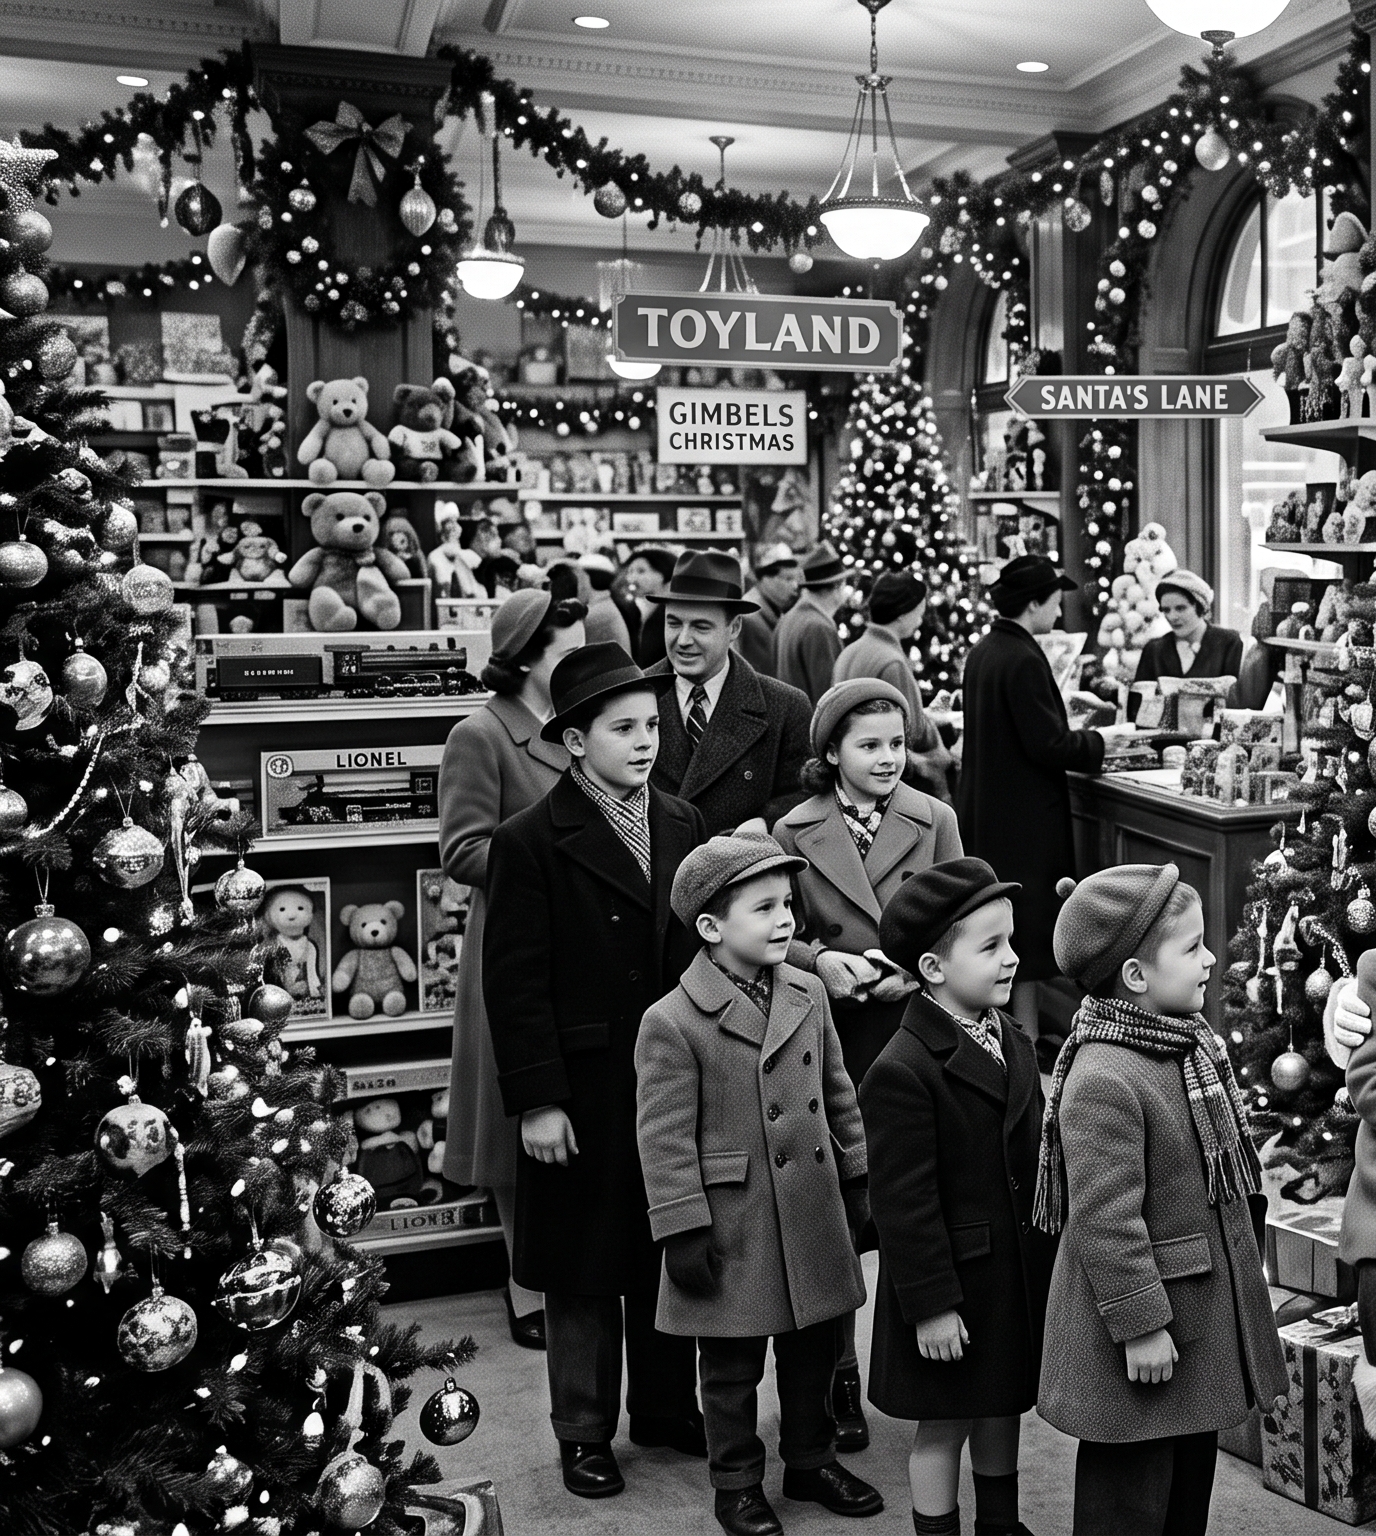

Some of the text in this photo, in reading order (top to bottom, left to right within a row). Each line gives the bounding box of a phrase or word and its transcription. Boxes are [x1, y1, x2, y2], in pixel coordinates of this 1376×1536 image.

[637, 307, 880, 354] TOYLAND
[1040, 385, 1229, 410] SANTA'S LANE
[669, 401, 794, 426] GIMBELS
[669, 432, 794, 451] CHRISTMAS
[337, 751, 407, 768] LIONEL
